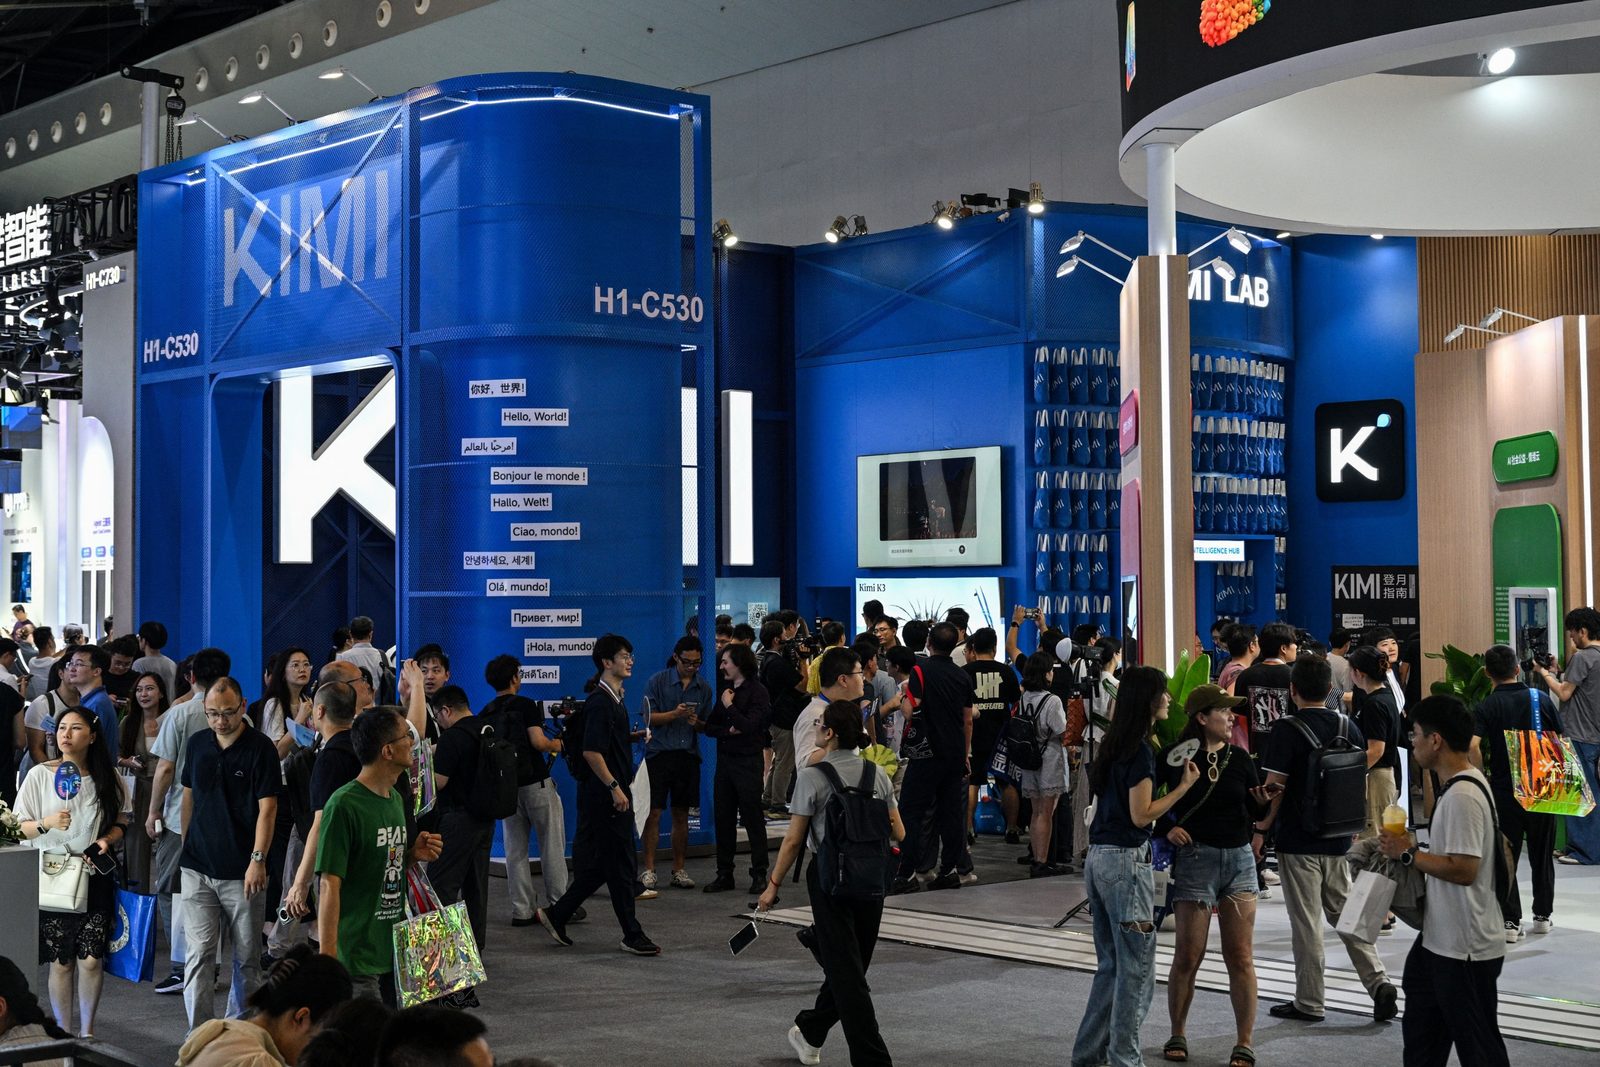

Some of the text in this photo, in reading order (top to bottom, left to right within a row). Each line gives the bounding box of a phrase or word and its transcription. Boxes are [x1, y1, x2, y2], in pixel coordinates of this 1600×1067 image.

[0, 203, 51, 268] 智能
[223, 169, 389, 308] KIMI
[85, 265, 120, 291] H1-C730
[1225, 274, 1269, 308] LAB
[594, 284, 704, 323] H1-C530
[143, 332, 199, 364] H1-C530
[503, 411, 567, 422] Hello, World!
[1330, 425, 1379, 484] K
[493, 471, 531, 483] Bonjour
[534, 471, 543, 481] le
[546, 471, 580, 481] monde
[493, 497, 549, 508] Hallo, Welt!
[513, 525, 578, 537] Ciao, mondo!
[465, 556, 533, 566] 안녕하세요, 세계!
[1383, 574, 1406, 586] 登月
[489, 582, 548, 592] Olá, mundo!
[859, 583, 886, 592] Kimi K3
[1334, 573, 1381, 600] KIMI
[1383, 587, 1408, 599] 指南
[514, 613, 580, 624] Привет, мир!
[527, 642, 595, 653] ¡Hola, mundo!
